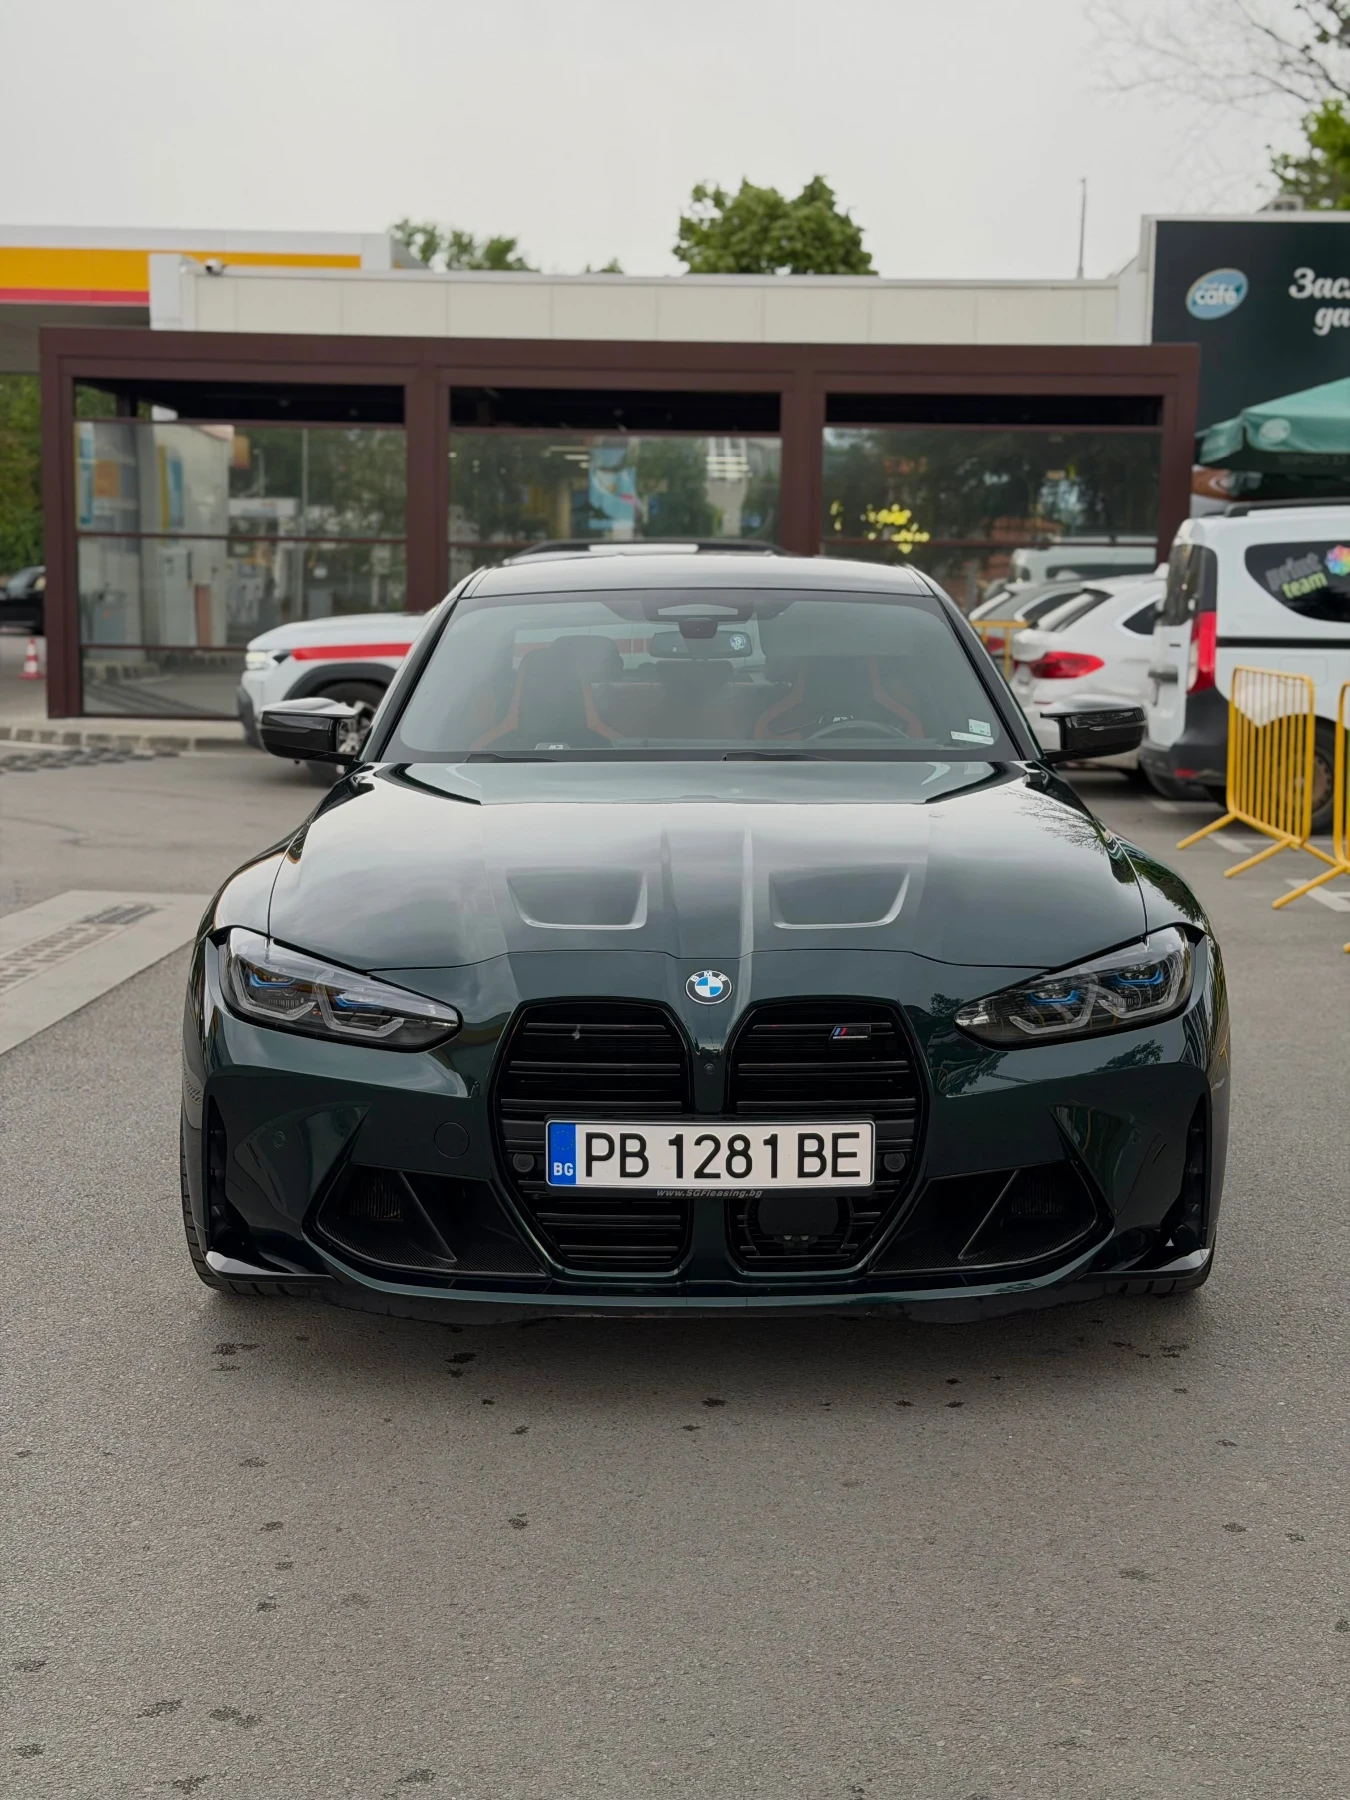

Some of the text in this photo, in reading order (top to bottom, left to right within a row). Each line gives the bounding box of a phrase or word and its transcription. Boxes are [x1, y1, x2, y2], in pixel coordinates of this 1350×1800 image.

[1281, 572, 1328, 599] team
[690, 969, 728, 982] BMW
[584, 1131, 861, 1179] PB 1281 BE
[553, 1161, 574, 1177] BG
[656, 1189, 763, 1198] www.SGFleasing.bg
